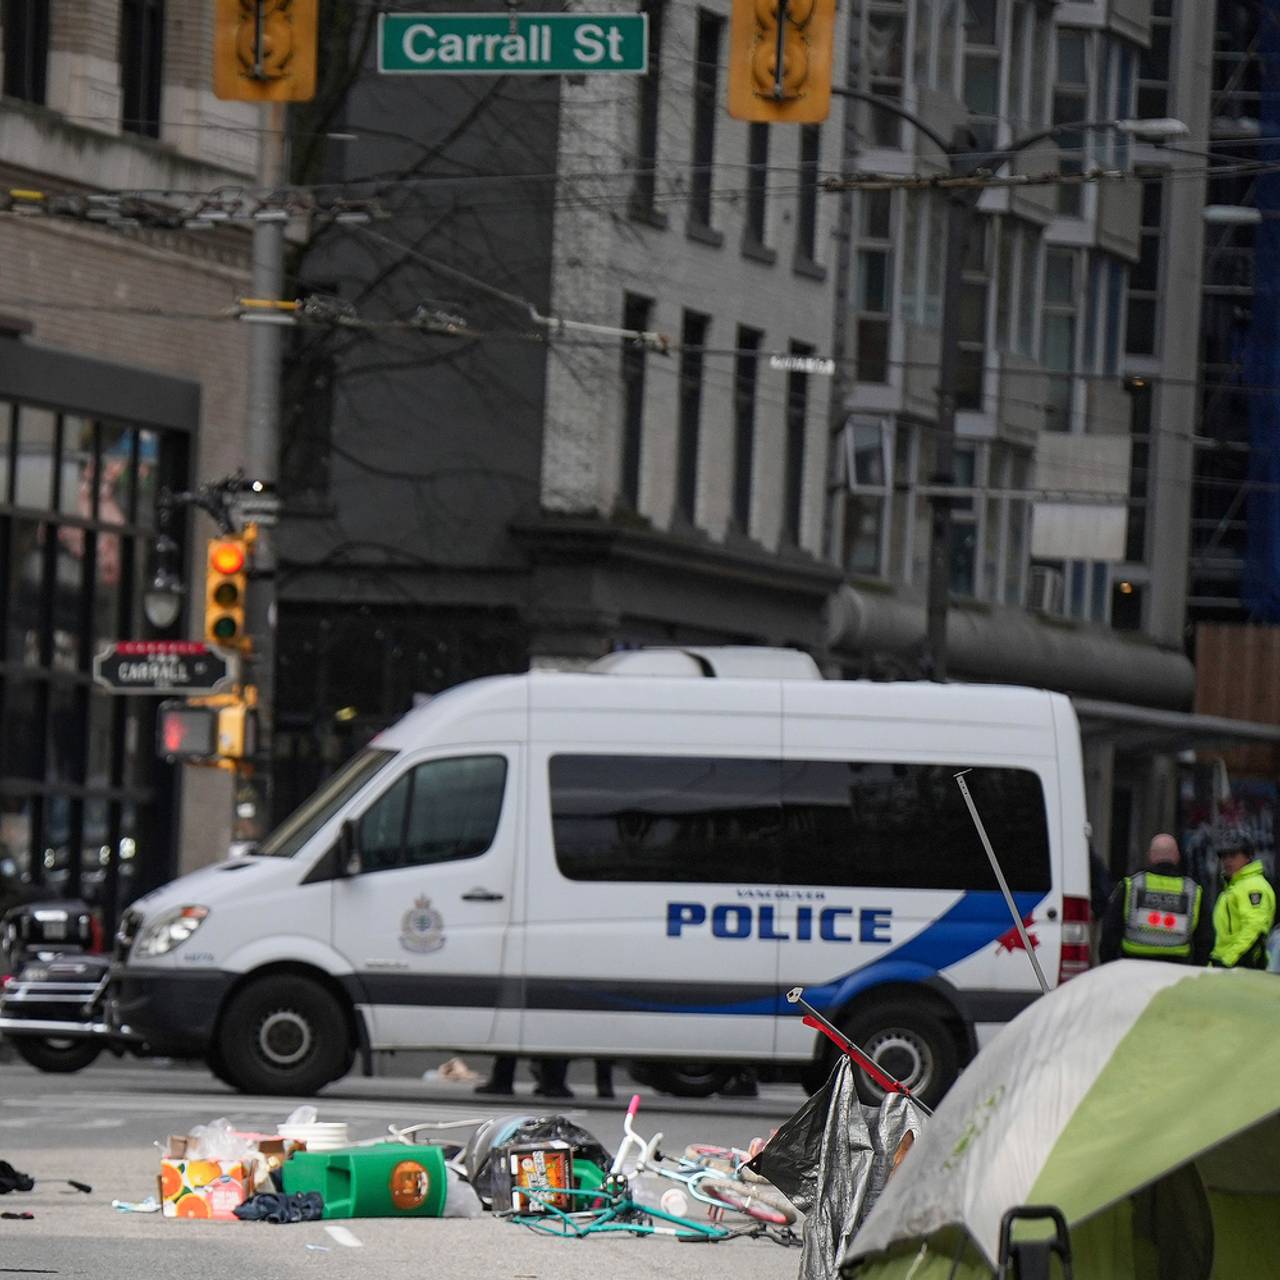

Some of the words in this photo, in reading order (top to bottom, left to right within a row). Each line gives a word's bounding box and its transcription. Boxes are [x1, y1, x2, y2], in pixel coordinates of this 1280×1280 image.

[402, 24, 552, 63] Carrall
[573, 24, 624, 63] St
[118, 662, 189, 681] CARRALL
[737, 889, 825, 900] VANCOUVER
[666, 902, 892, 943] POLICE
